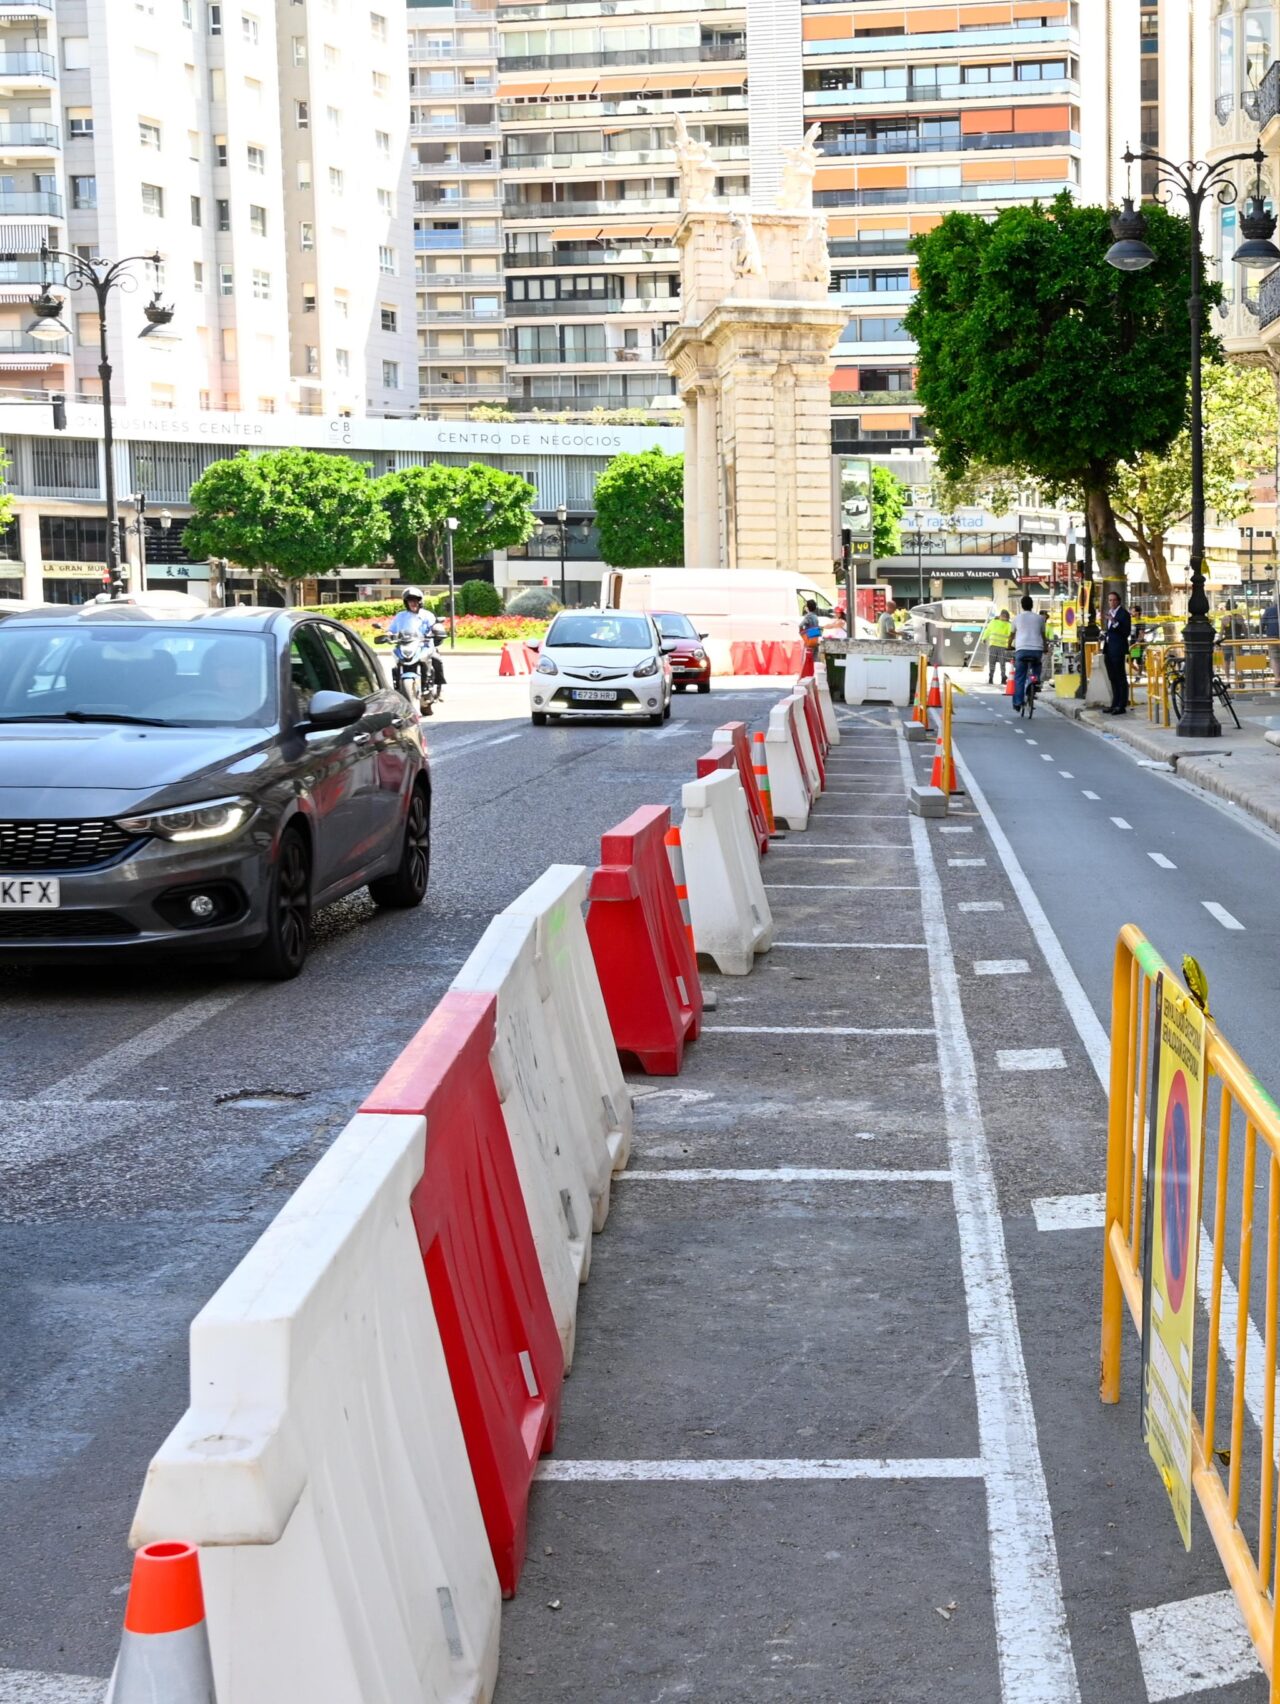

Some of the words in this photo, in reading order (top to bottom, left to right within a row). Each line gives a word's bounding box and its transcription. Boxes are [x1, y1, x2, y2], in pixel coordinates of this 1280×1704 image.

[199, 422, 263, 436] CENTER
[437, 432, 501, 445] CENTRO
[511, 434, 530, 446] DE
[540, 435, 622, 447] NEGOCIOS
[0, 881, 52, 904] KFX
